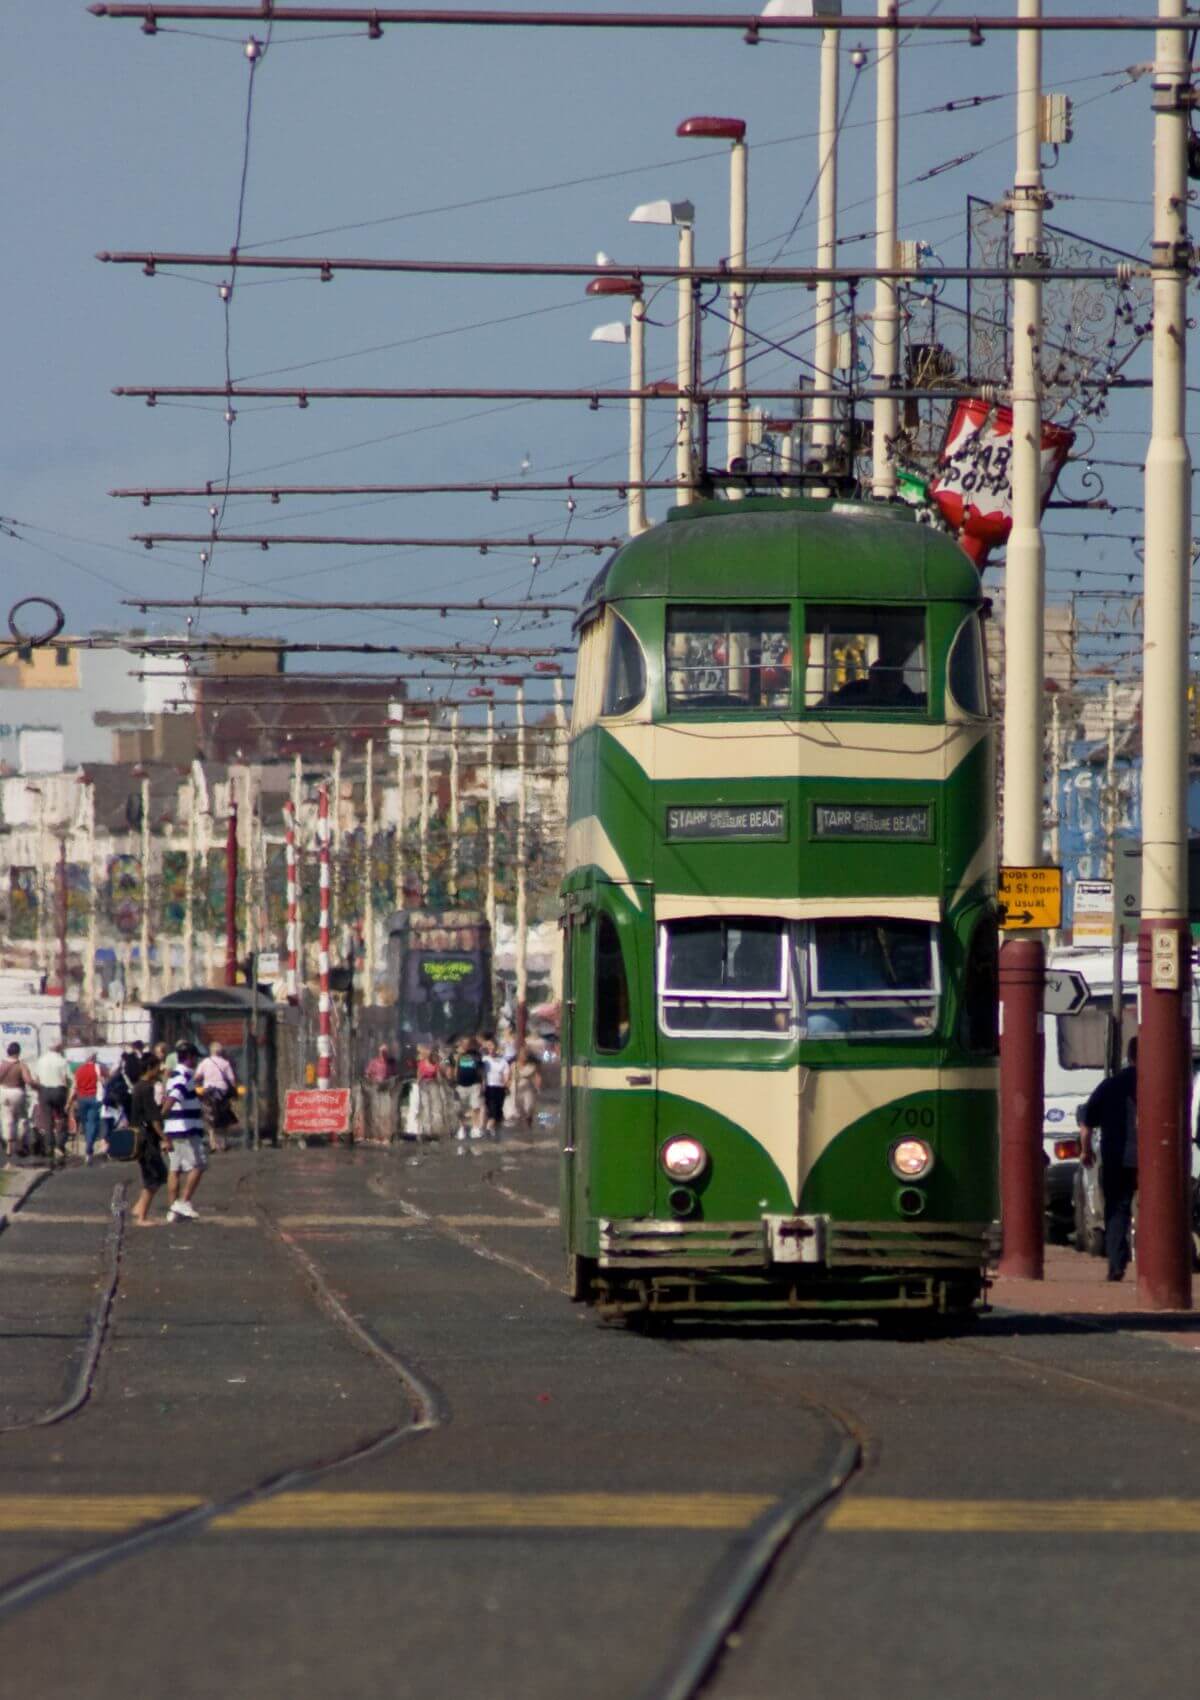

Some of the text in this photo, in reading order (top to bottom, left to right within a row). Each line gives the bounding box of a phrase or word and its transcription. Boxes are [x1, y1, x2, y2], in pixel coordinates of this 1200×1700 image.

[943, 466, 1013, 499] POPP
[670, 808, 707, 828] STARR
[750, 809, 783, 827] BEACH
[817, 808, 852, 832] TARR
[893, 813, 926, 833] BEACH
[1001, 870, 1045, 880] hops on
[1016, 883, 1028, 894] St
[1032, 886, 1060, 896] open
[1015, 899, 1045, 908] usual
[890, 1108, 935, 1128] 700
